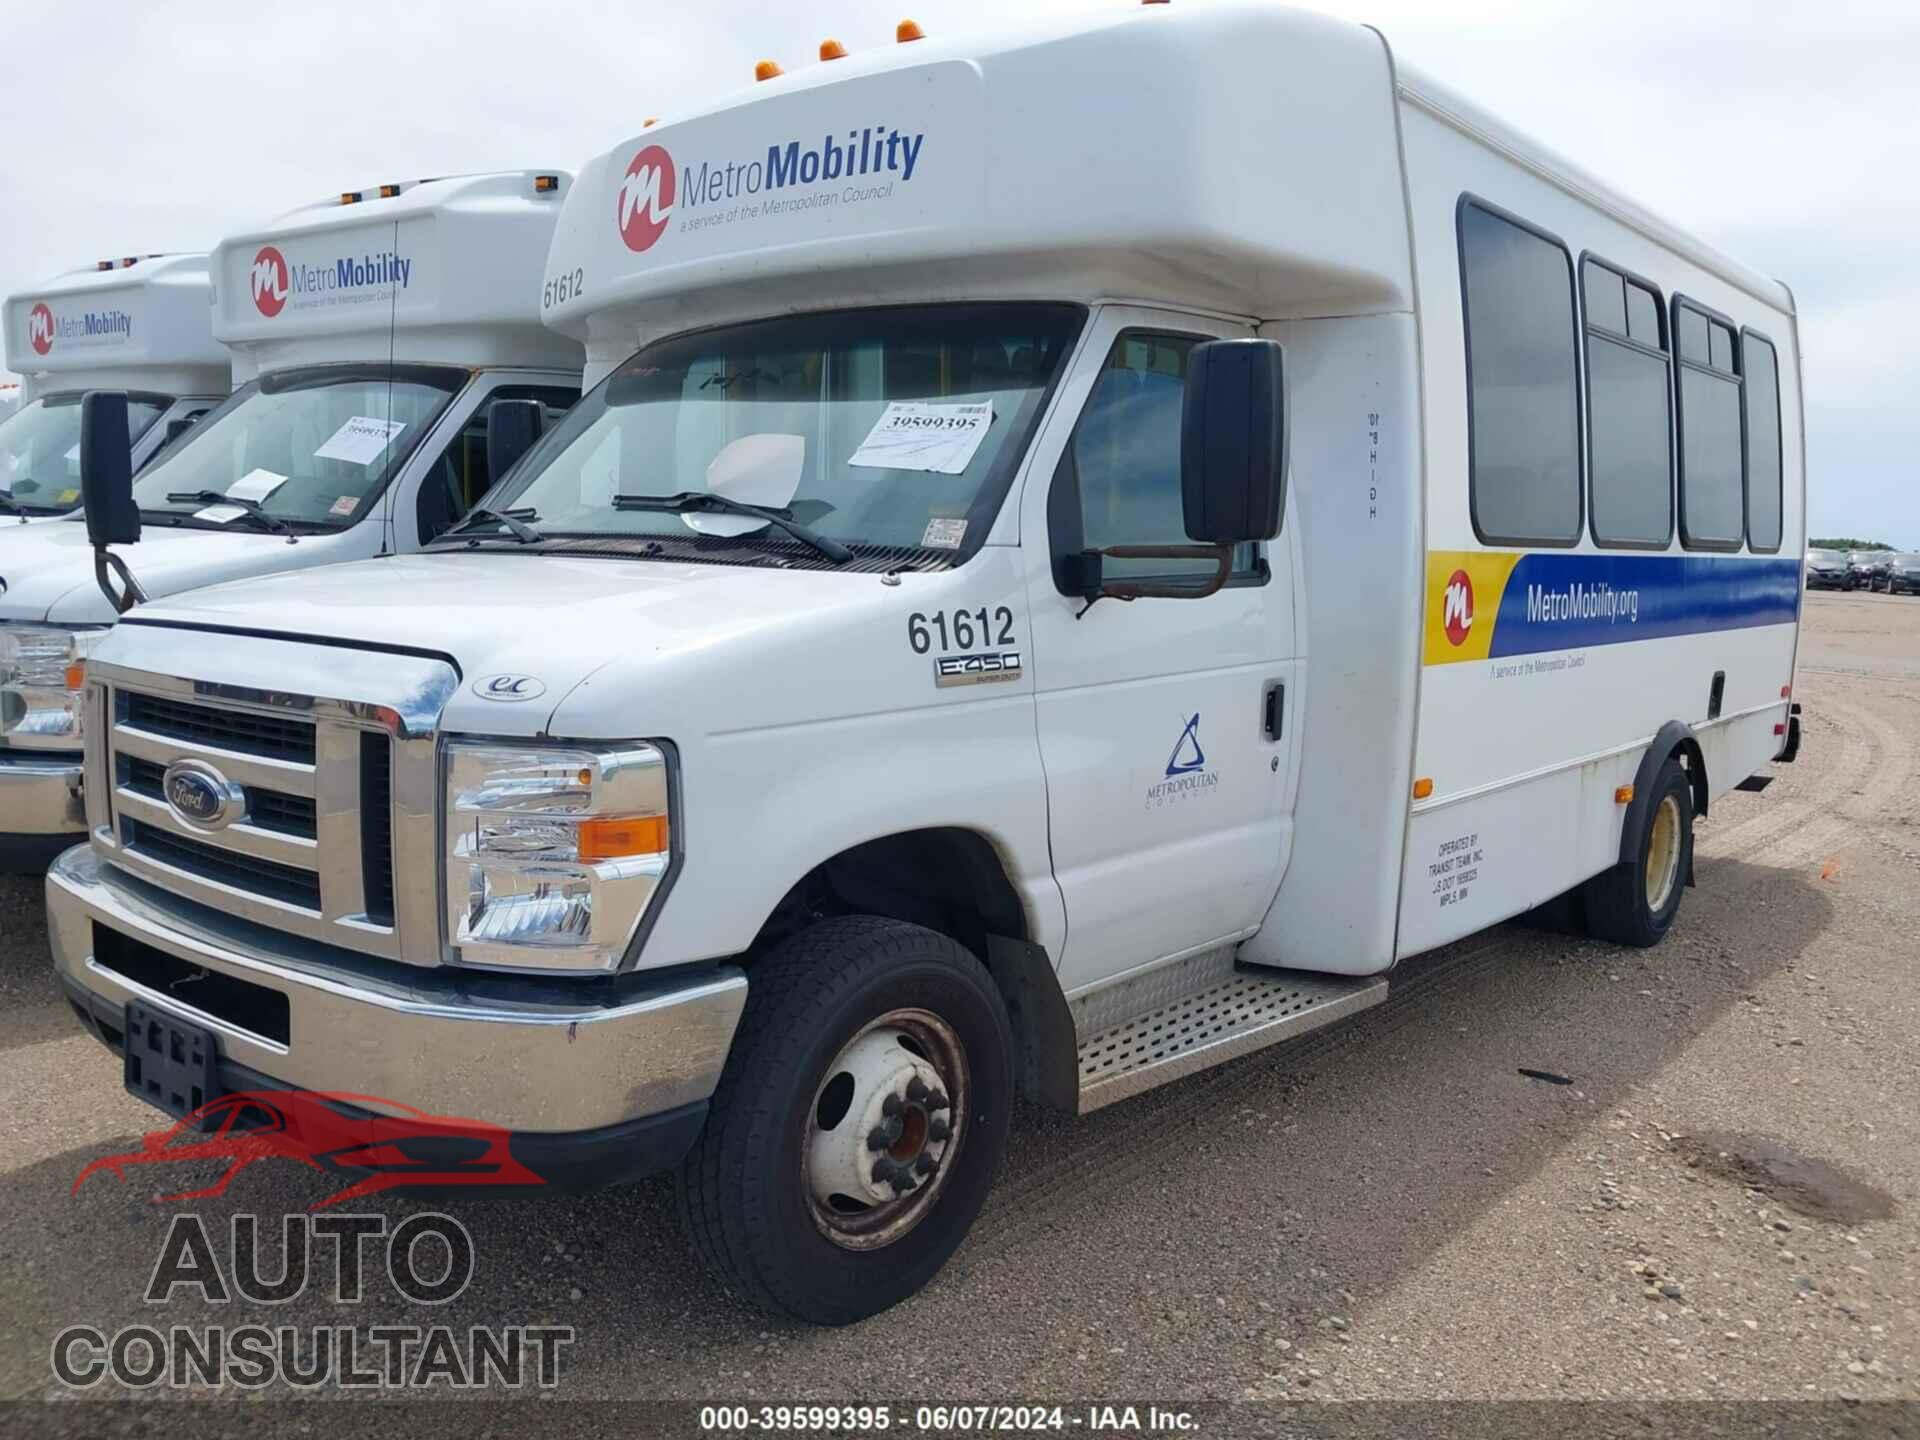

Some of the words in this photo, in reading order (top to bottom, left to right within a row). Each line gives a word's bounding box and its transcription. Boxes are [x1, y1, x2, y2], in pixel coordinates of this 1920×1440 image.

[680, 126, 924, 209] MetroMobility
[688, 213, 723, 231] service
[726, 208, 738, 224] of
[740, 206, 758, 220] the
[761, 190, 839, 216] Metropolitan
[841, 181, 894, 204] Council
[543, 266, 584, 309] 61612
[1526, 581, 1639, 624] MetroMobility.org
[907, 605, 1016, 655] 61612
[172, 777, 206, 811] Ford
[1146, 771, 1219, 799] METROPOLITAN
